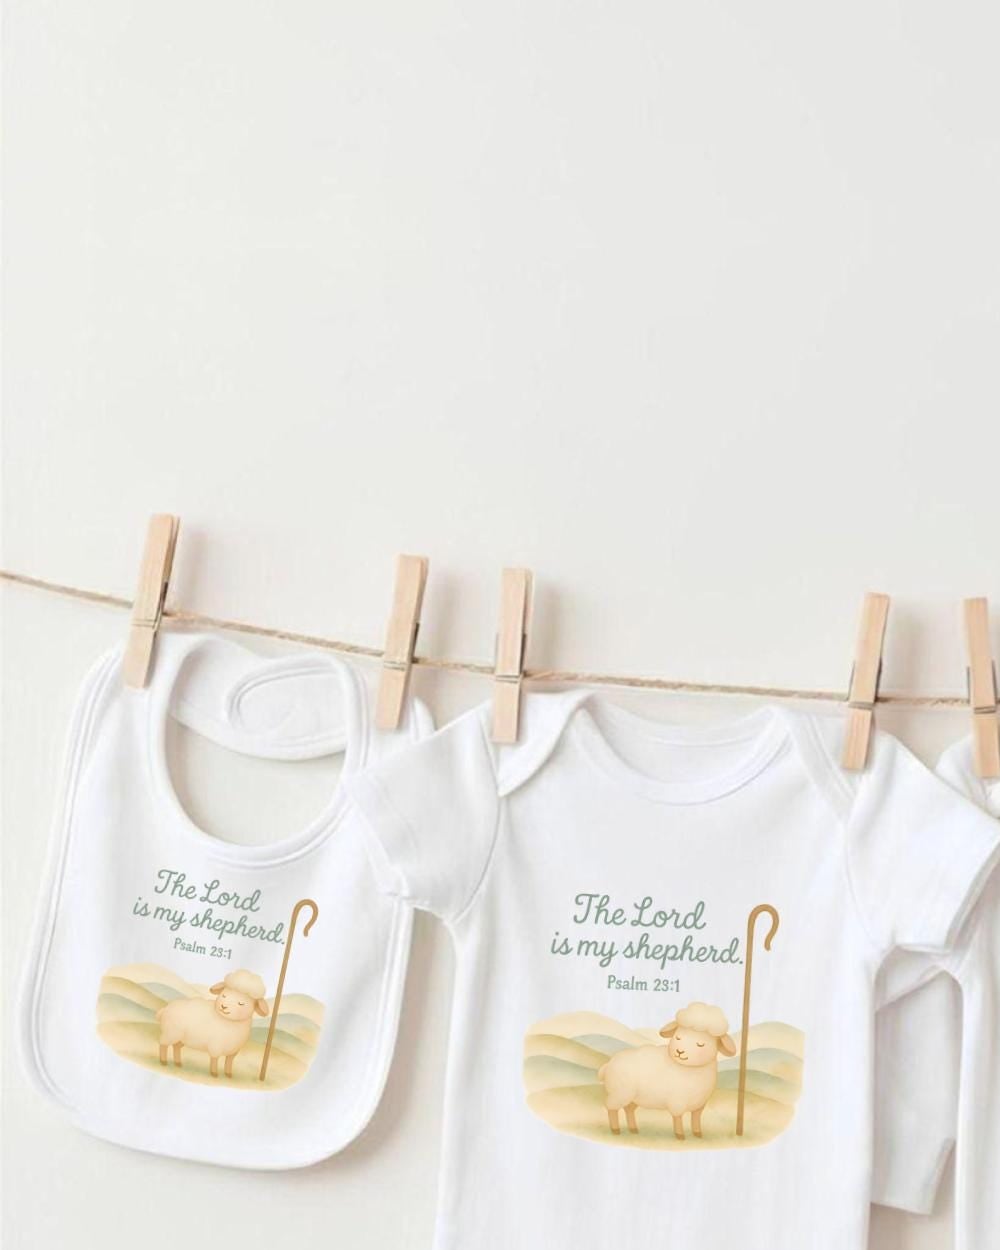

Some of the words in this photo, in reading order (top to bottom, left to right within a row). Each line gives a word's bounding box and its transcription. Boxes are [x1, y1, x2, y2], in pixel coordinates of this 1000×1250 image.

[154, 869, 197, 899] The
[200, 880, 261, 912] Lord
[133, 897, 151, 916] is
[153, 907, 186, 931] my
[190, 908, 285, 944] shepherd.
[574, 893, 626, 925] The
[631, 897, 706, 930] Lord
[174, 937, 206, 954] Psalm
[210, 946, 232, 959] 23:1
[551, 932, 573, 955] is
[577, 940, 618, 968] my
[622, 933, 743, 970] shepherd.
[607, 975, 648, 991] Psalm
[653, 979, 680, 992] 23:1
